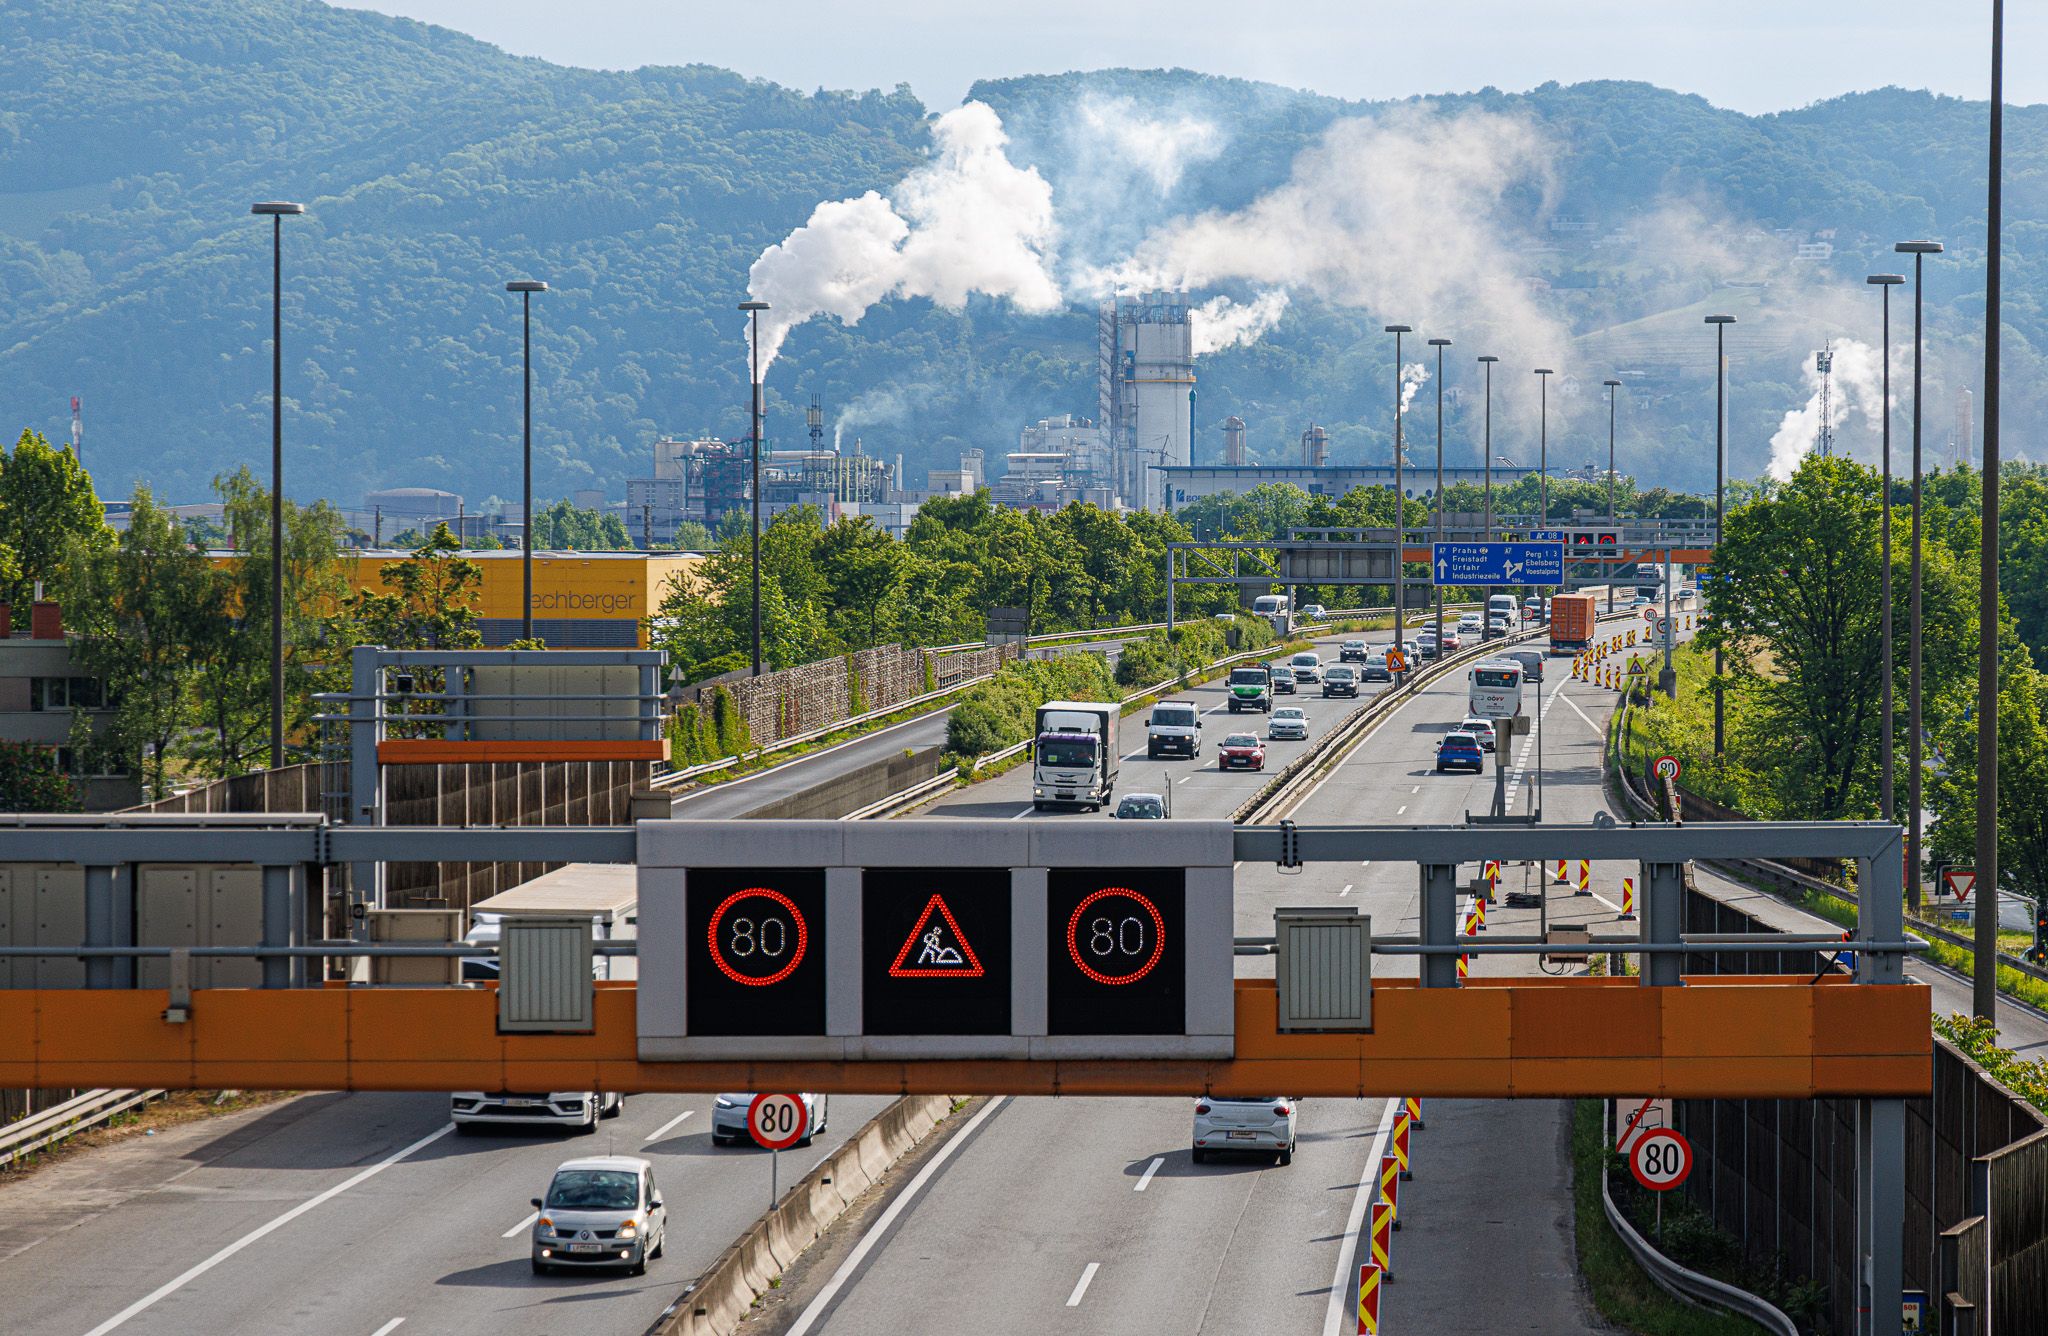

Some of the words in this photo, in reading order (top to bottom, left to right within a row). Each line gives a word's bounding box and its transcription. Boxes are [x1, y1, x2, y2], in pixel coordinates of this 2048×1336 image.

[1452, 546, 1477, 554] Praha
[1525, 550, 1542, 558] Perg
[1452, 555, 1488, 563] Freistadt
[1525, 559, 1560, 568] Ebelsberg
[1452, 572, 1501, 580] Industriezeile
[1525, 568, 1560, 576] Voestalpine
[530, 590, 636, 614] echberger
[731, 917, 786, 957] 80
[1091, 917, 1143, 956] 80
[761, 1103, 793, 1133] 80
[1645, 1143, 1679, 1175] 80
